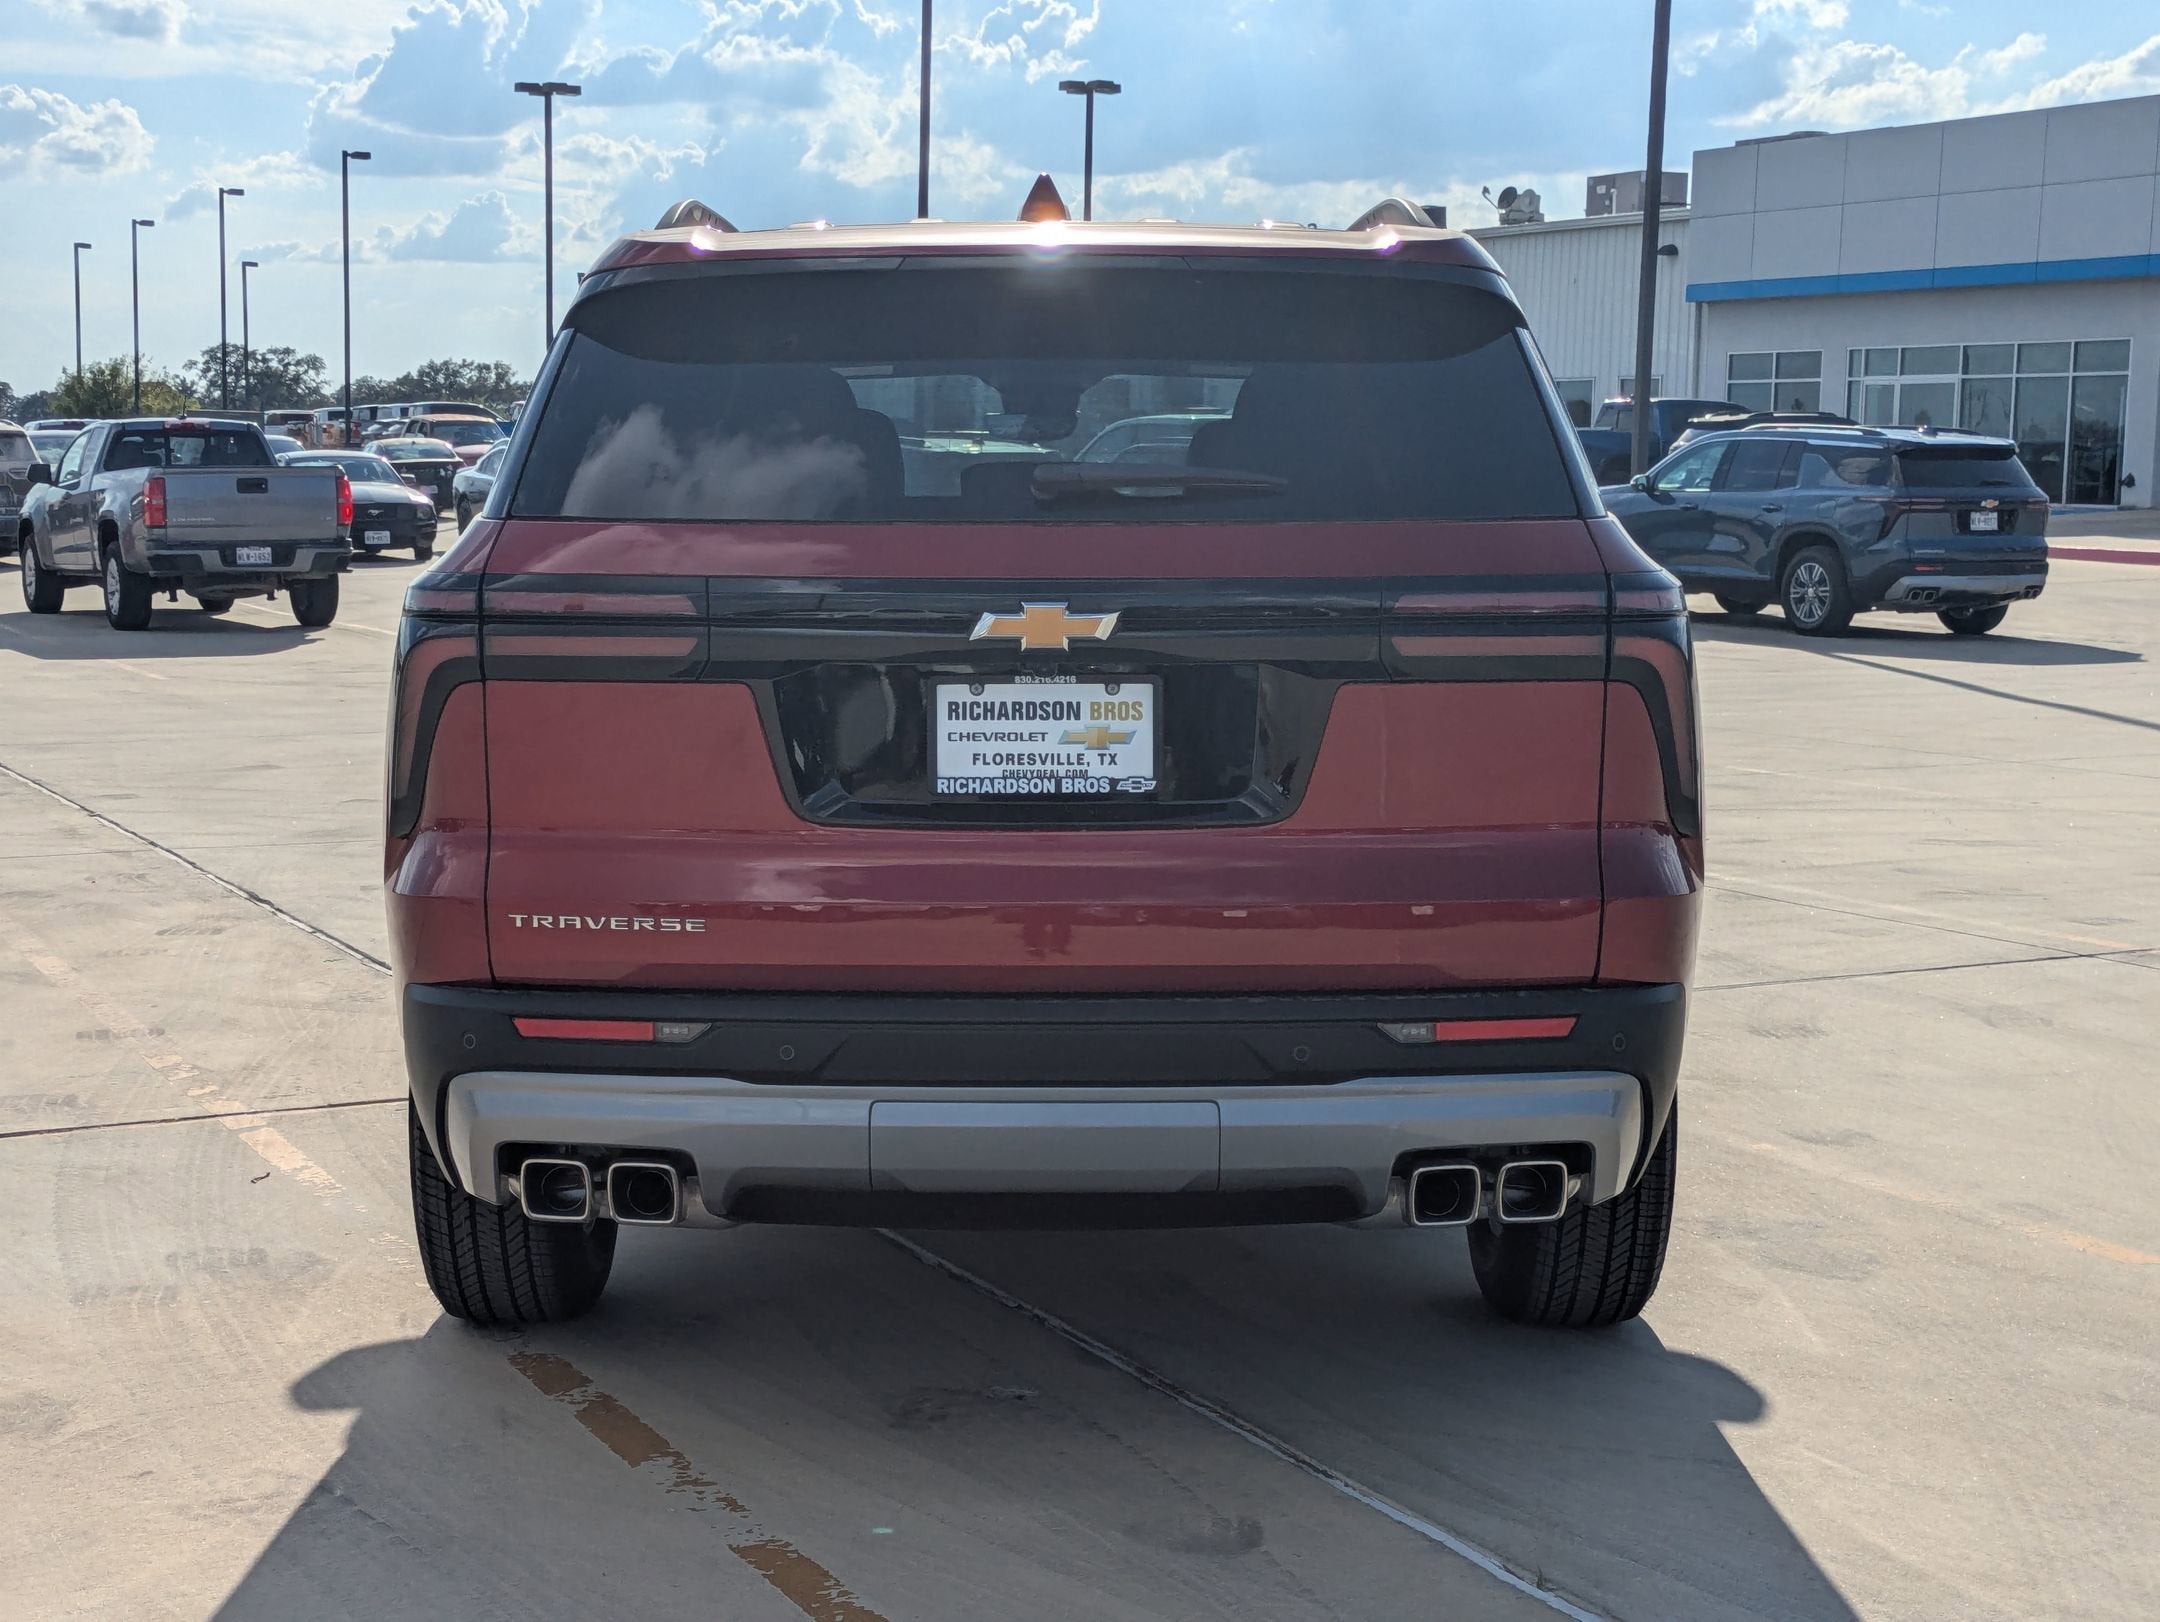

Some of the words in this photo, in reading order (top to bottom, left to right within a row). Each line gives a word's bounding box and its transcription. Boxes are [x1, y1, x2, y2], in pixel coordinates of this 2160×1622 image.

[947, 701, 1081, 721] RICHARDSON
[1089, 701, 1144, 721] BROS
[947, 732, 1049, 742] CHEVROLET
[972, 753, 1091, 767] FLORESVILLE,
[1097, 753, 1118, 766] TX
[1002, 769, 1089, 778] CHEVYDEALCOM
[937, 778, 1056, 794] RICHARDSON
[1061, 778, 1110, 794] BROS
[508, 914, 706, 932] TRAVERSE
